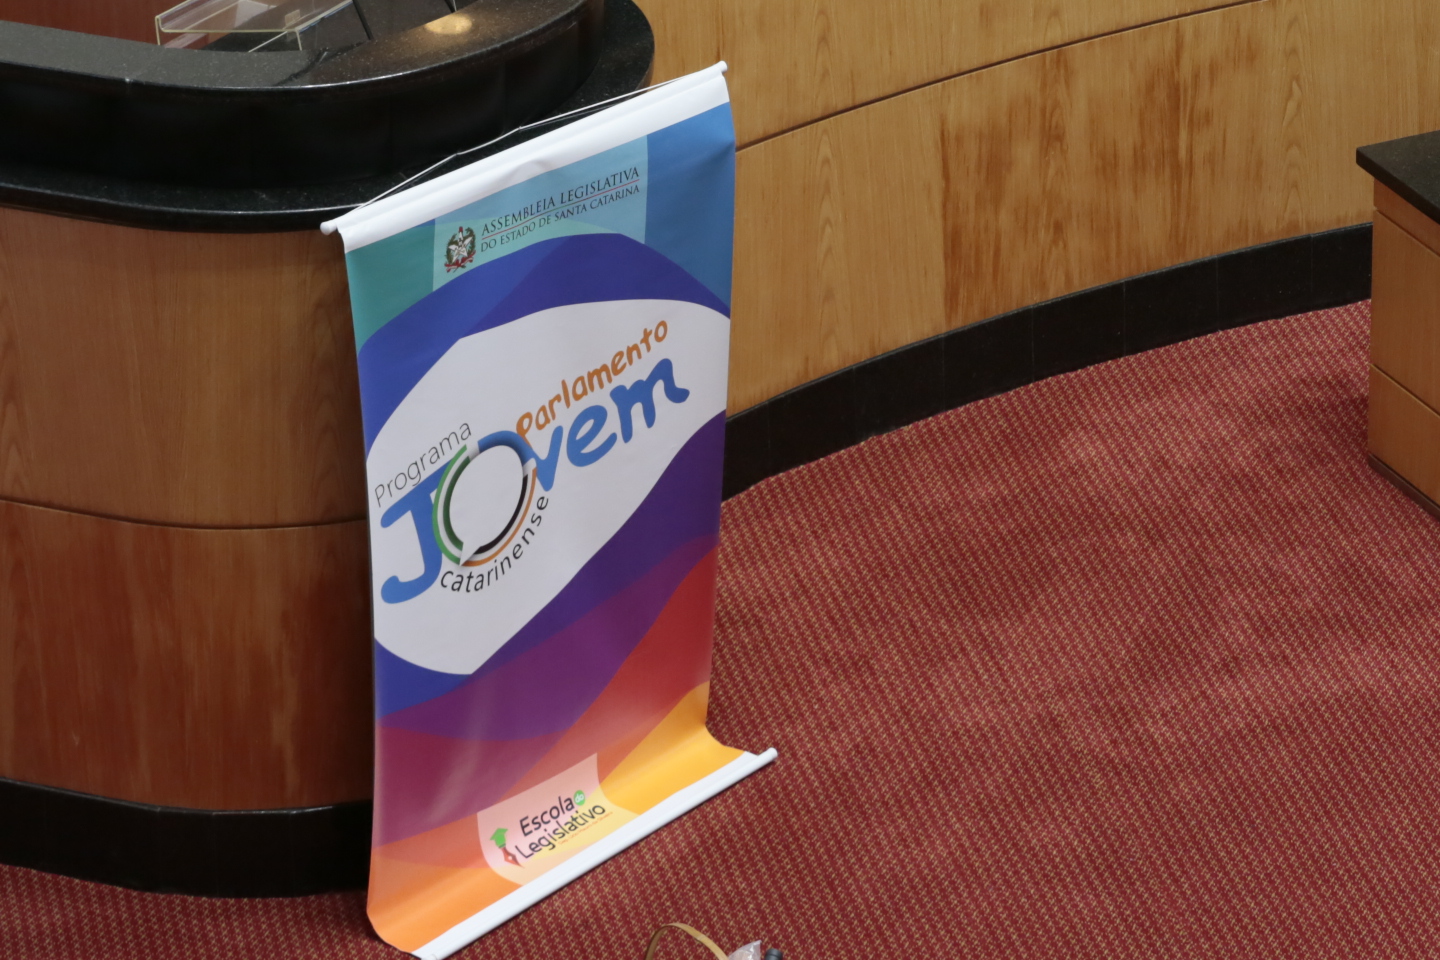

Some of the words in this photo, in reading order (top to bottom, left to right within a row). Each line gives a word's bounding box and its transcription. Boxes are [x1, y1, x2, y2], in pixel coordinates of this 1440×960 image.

[480, 238, 497, 253] DO
[500, 221, 536, 246] ESTADO
[538, 214, 552, 228] DE
[554, 202, 588, 222] SANTA
[589, 184, 640, 210] CATARINA
[481, 196, 556, 237] ASSEMBLEIA
[560, 166, 640, 205] LEGISLATIVA
[515, 320, 668, 449] Parlamento
[374, 422, 472, 508] Programa
[514, 804, 606, 859] Legislativo
[519, 795, 575, 837] Escola
[574, 792, 585, 804] do
